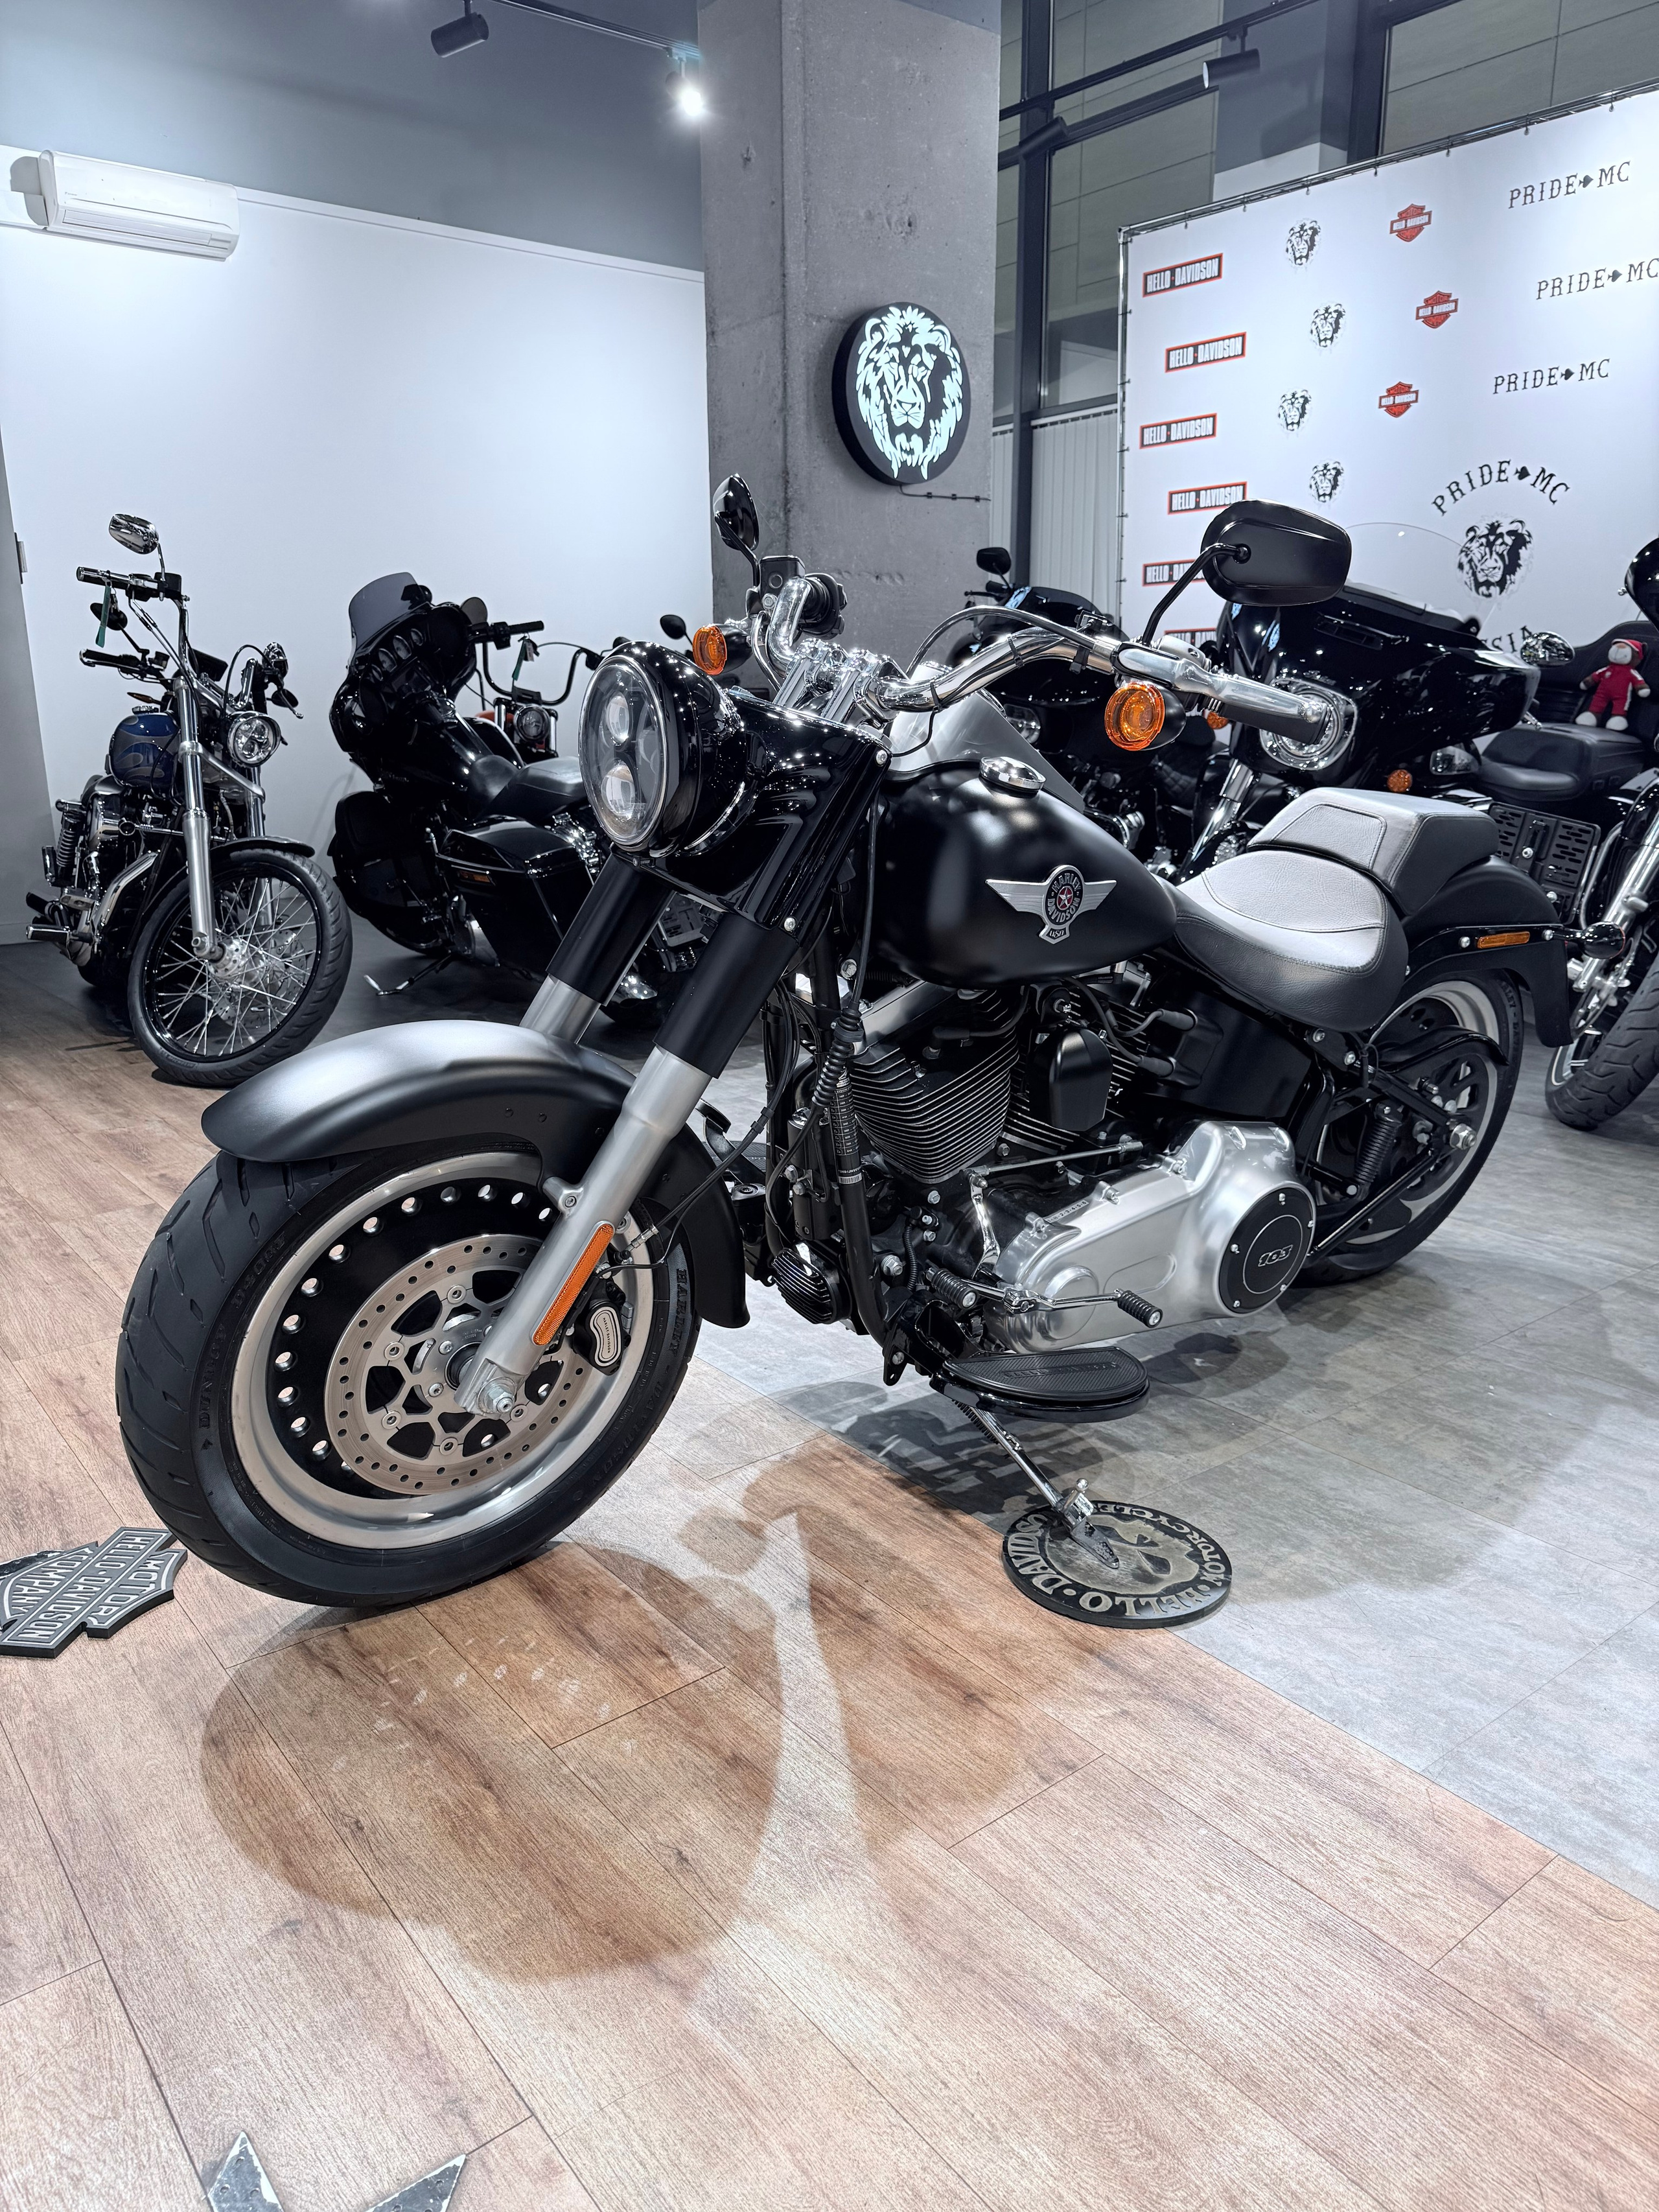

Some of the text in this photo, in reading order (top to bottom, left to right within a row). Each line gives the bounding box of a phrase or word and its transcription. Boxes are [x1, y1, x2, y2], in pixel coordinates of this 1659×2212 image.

[1508, 161, 1631, 209] PRIDE MC
[1146, 257, 1219, 292] HELLO DAVIDSON
[1536, 258, 1659, 300] PRIDE MC
[1169, 334, 1242, 369] HELLO DAVIDSON
[1492, 358, 1610, 395] PRIDE MC
[1143, 417, 1214, 445] HELLO DAVIDSON
[1172, 485, 1244, 511] HELLO DAVIDSON
[1432, 459, 1570, 517] PRIDE MC
[1146, 565, 1169, 583] HELLO
[1051, 872, 1081, 893] HARLEY
[1047, 897, 1081, 923] DAVIDSON
[1258, 1244, 1294, 1267] 103
[668, 1268, 688, 1357] HARLEY
[11, 1554, 89, 1612] COMPANY
[1008, 1513, 1211, 1616] HELLO DAVIDS
[17, 1535, 154, 1639] HELLO DAVIDSON
[98, 1560, 165, 1616] MOTOR
